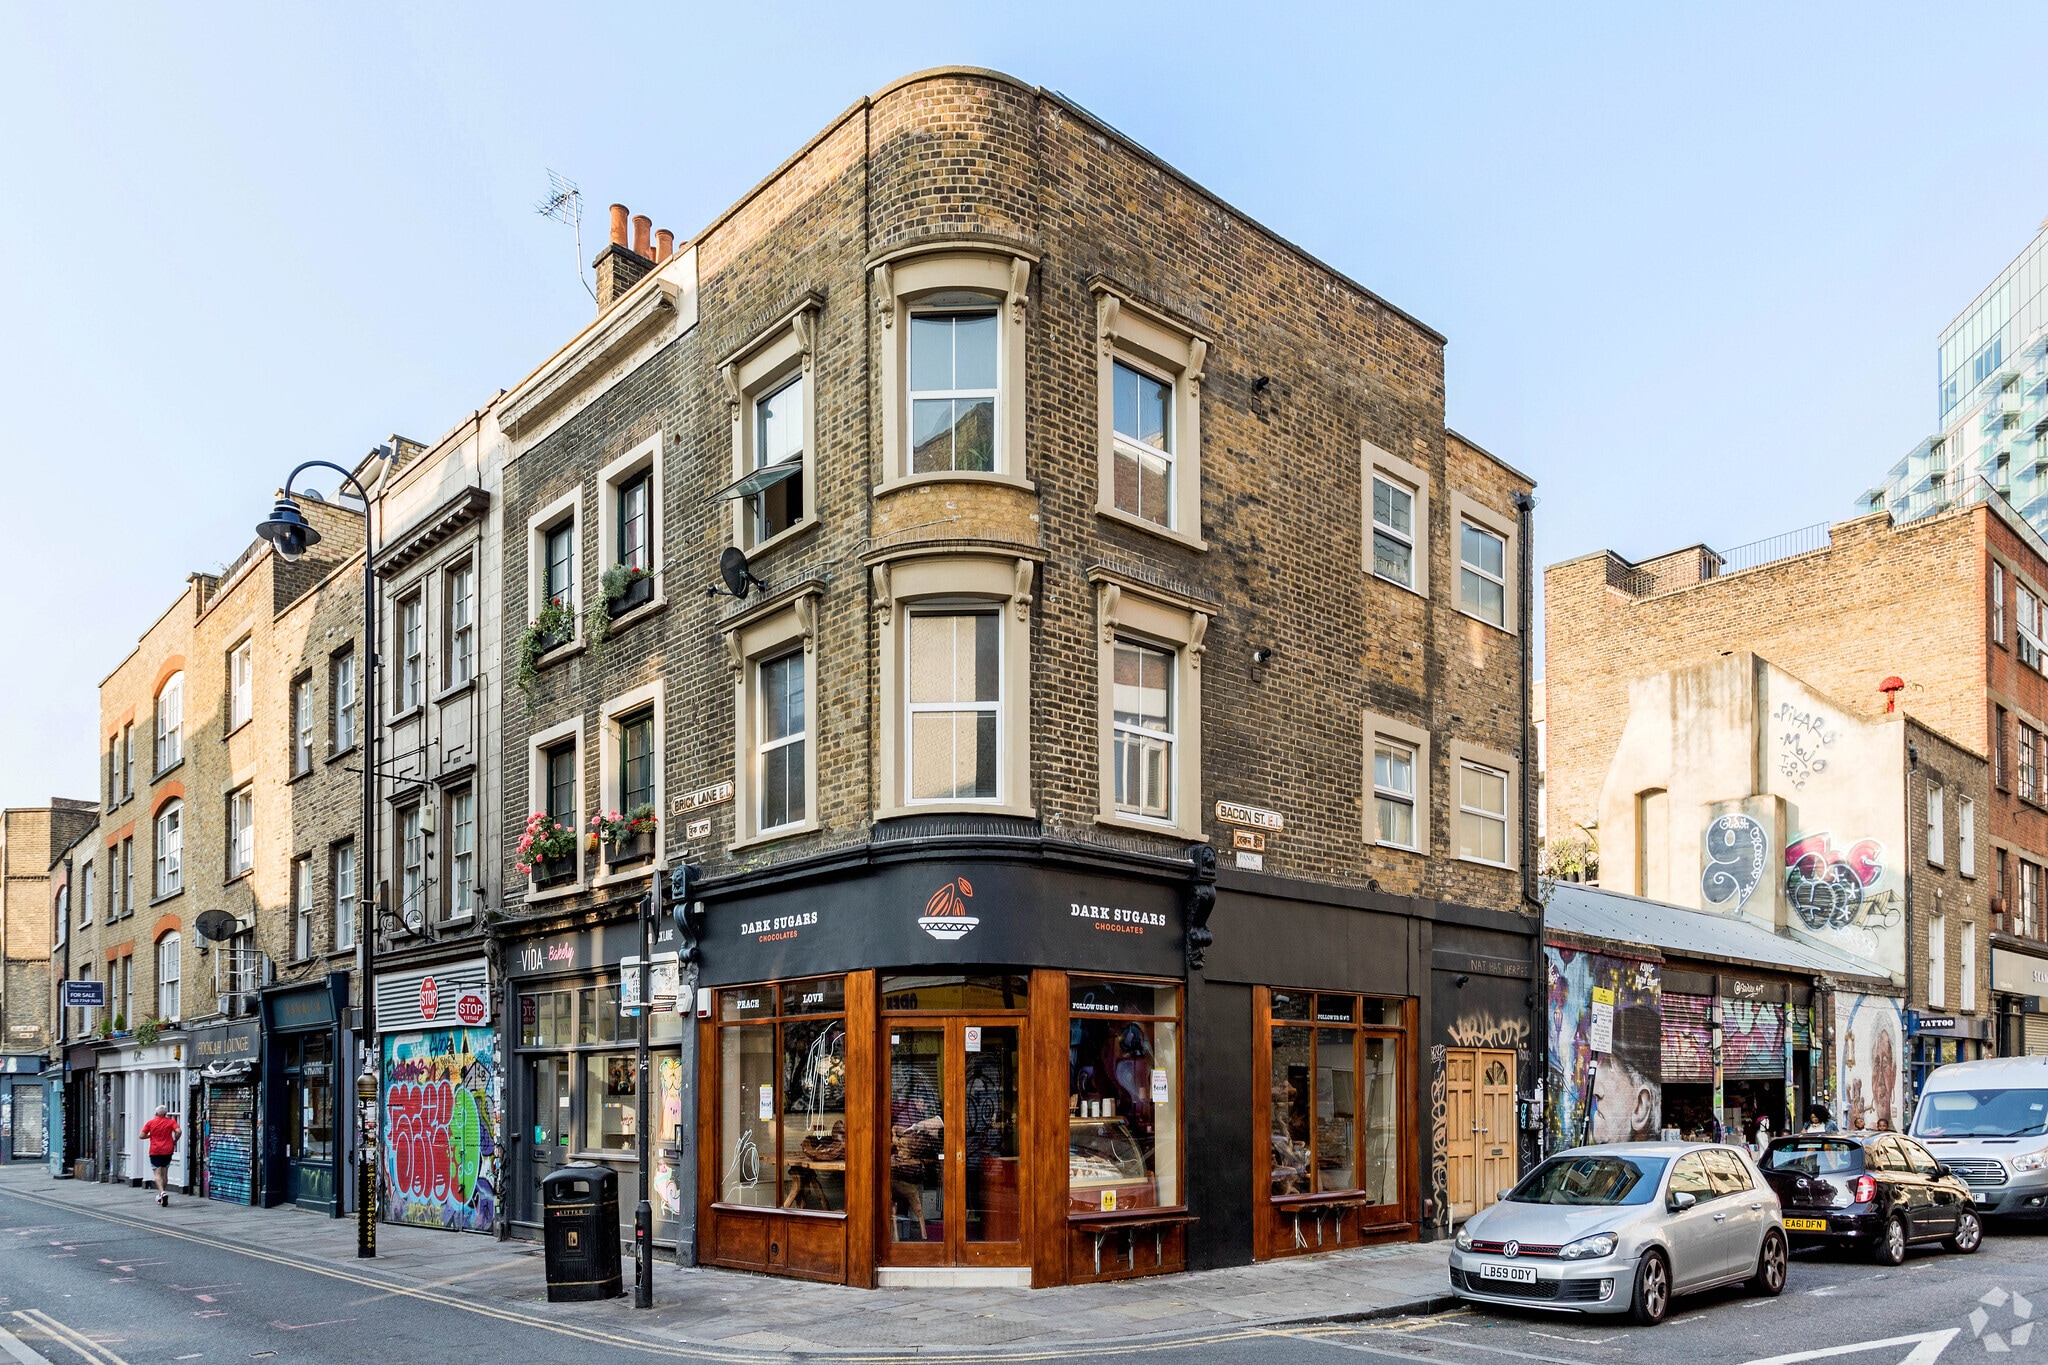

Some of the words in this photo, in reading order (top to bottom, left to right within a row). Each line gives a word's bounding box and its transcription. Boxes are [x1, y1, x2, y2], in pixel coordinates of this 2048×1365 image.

[674, 795, 696, 812] BRICK
[697, 789, 717, 805] LANE
[1220, 805, 1251, 824] BACON
[1254, 812, 1266, 825] ST.
[741, 919, 771, 935] DARK
[774, 911, 818, 930] SUGARS
[1070, 903, 1110, 919] DARK
[1114, 908, 1166, 926] SUGARS
[758, 930, 798, 943] CHOCOLATES
[1095, 922, 1144, 935] CHOCOLATES
[521, 944, 544, 971] VIDA
[548, 942, 575, 967] Bakery
[1470, 959, 1487, 971] NAT
[1489, 962, 1502, 974] HAS
[1504, 964, 1529, 977] HERPES
[421, 989, 437, 1007] STOP
[736, 999, 760, 1009] PEACE
[802, 993, 824, 1004] LOVE
[459, 1003, 483, 1015] STOP
[1920, 1019, 1954, 1027] TATTOO
[197, 1040, 222, 1055] HOOKAH
[224, 1036, 249, 1054] LOUNGE
[1785, 1220, 1804, 1228] EA61
[1805, 1220, 1822, 1228] DFN
[1483, 1266, 1509, 1279] LB59
[1511, 1269, 1532, 1281] ODY
